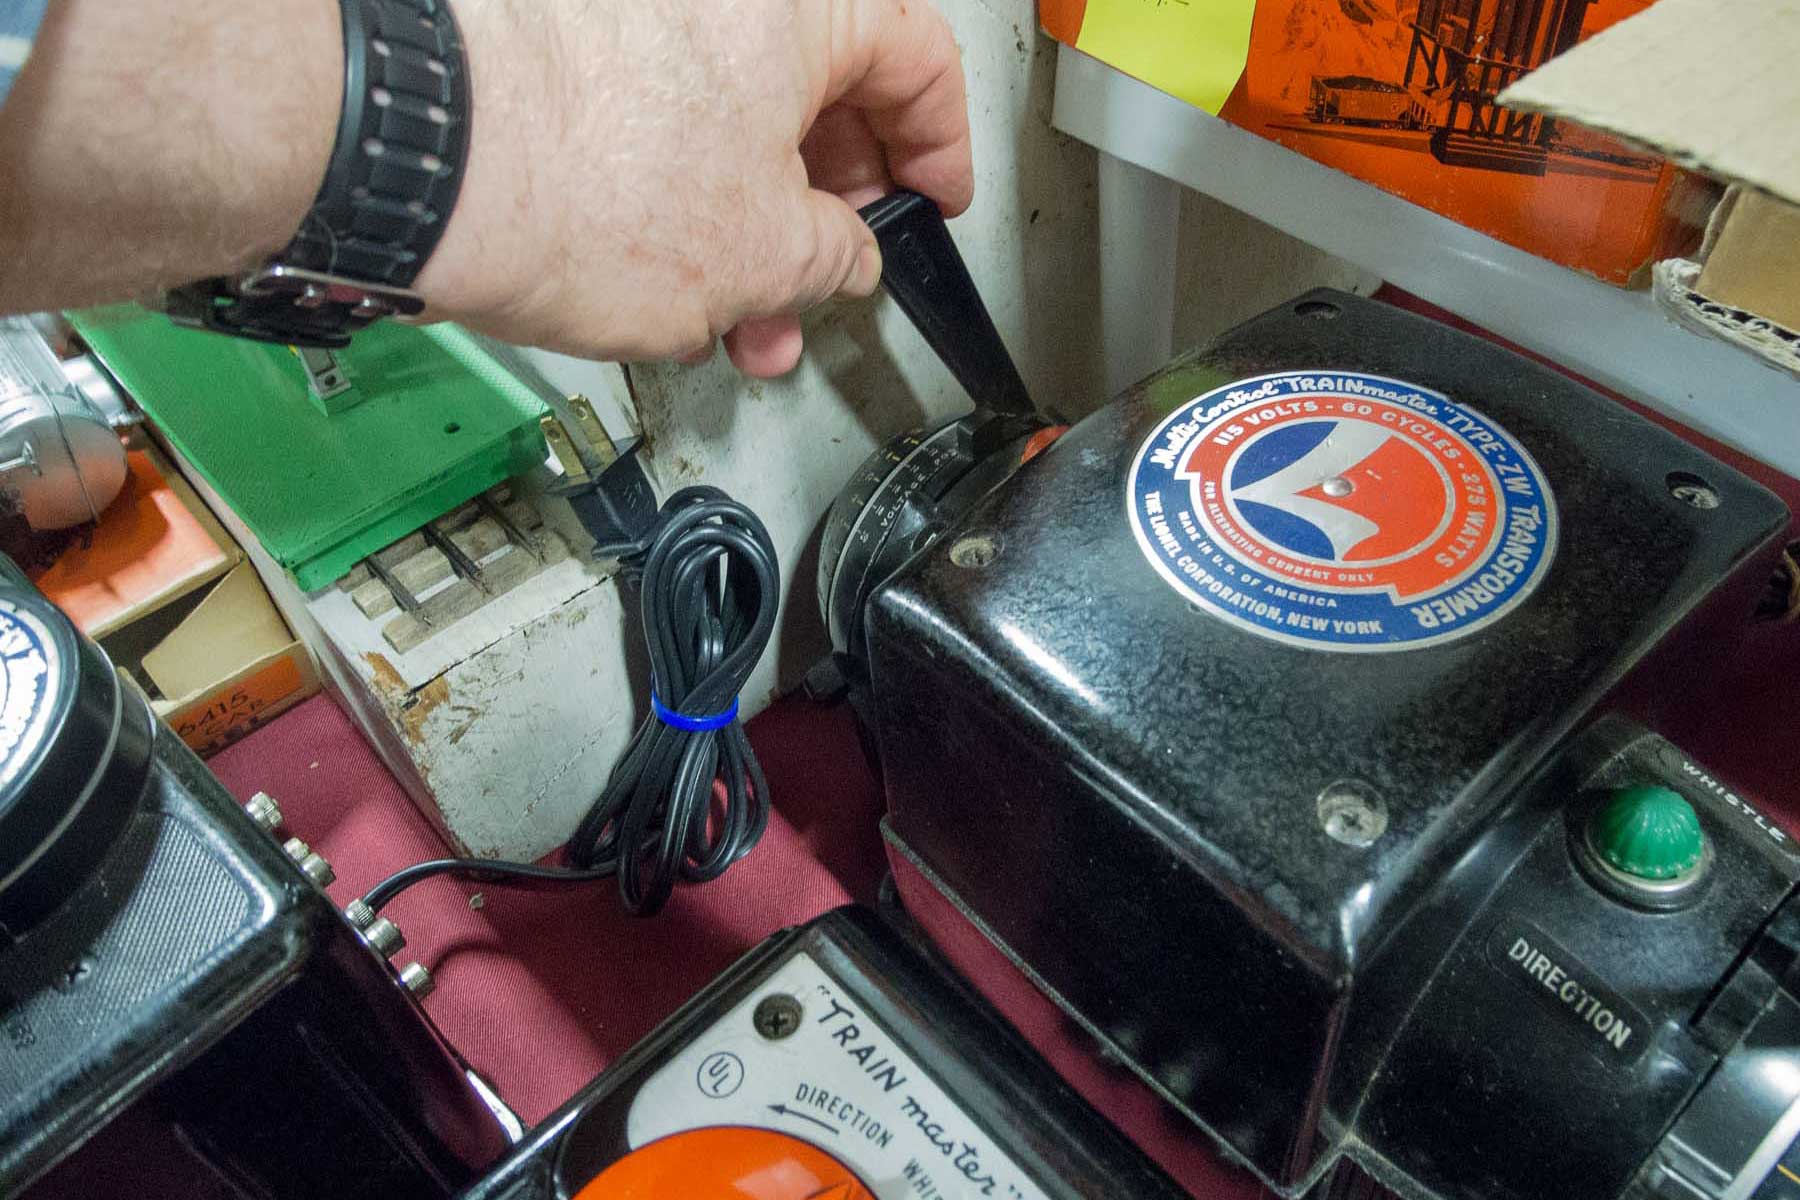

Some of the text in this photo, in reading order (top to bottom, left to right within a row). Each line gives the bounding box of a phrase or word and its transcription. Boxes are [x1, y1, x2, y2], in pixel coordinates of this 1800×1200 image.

[1144, 490, 1163, 516] THE
[1212, 400, 1487, 567] 115 VOLTS 60 CYCLES 275 WATTS
[1149, 514, 1183, 558] LIONEL
[1178, 511, 1201, 541] MADE
[1197, 541, 1213, 555] IN
[1240, 573, 1262, 586] OF
[1264, 583, 1337, 608] AMERICA
[1208, 502, 1263, 558] ALTERNATING
[1267, 556, 1331, 581] CURRENT
[1338, 572, 1375, 583] ONLY
[1410, 504, 1542, 628] TRANSFORMER
[1286, 611, 1329, 632] NEW
[1333, 619, 1384, 634] YORK
[1682, 760, 1787, 843] WHISTLE
[1508, 936, 1633, 1049] DIRECTION
[795, 1082, 894, 1149] DIRECTION
[903, 1158, 944, 1200] WHI
